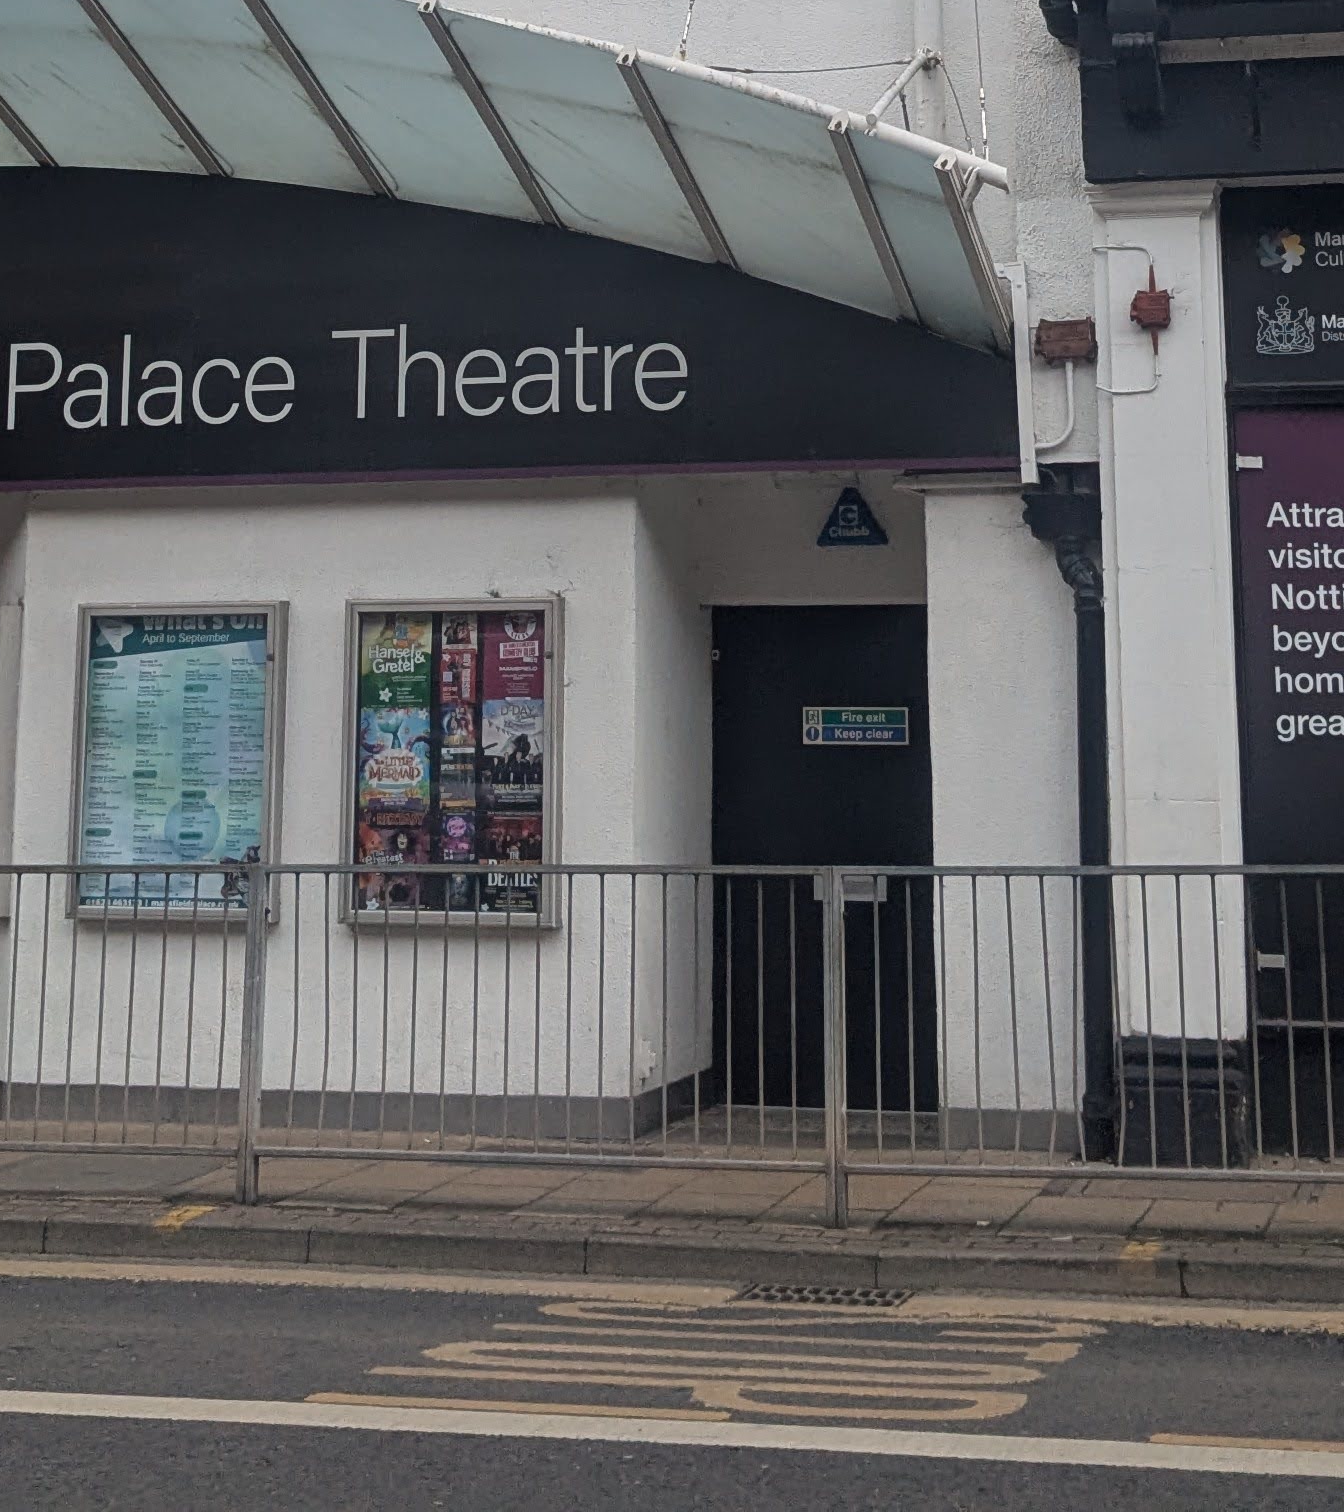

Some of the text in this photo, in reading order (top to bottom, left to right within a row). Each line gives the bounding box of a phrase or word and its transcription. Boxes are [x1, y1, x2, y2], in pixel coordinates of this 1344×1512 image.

[7, 323, 689, 430] Palace Theatre
[829, 525, 870, 538] Chubb
[142, 632, 230, 645] April to September
[369, 644, 426, 664] Hansel &
[372, 657, 415, 674] Gretel
[841, 712, 886, 723] Fire exit
[834, 728, 894, 740] Keep clear
[365, 1301, 1108, 1420] STOP
